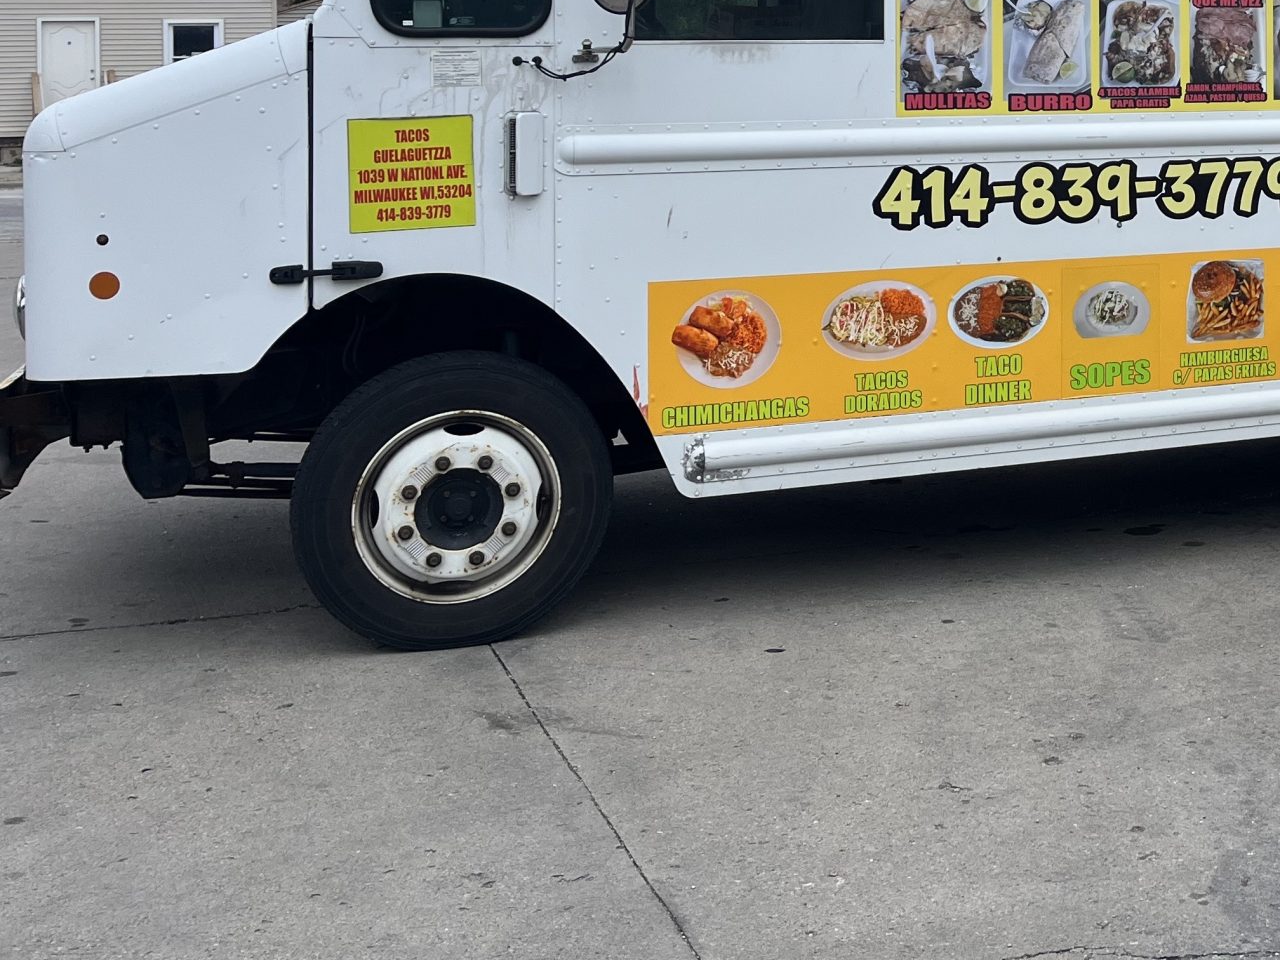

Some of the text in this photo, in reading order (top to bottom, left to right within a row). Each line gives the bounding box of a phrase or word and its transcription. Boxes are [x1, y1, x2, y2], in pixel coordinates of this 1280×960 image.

[905, 92, 991, 110] MULITAS
[1009, 93, 1092, 111] BURRO
[1098, 87, 1180, 97] 4 TACOS ALAMBRE
[1111, 99, 1169, 108] PAPA GRATIS
[394, 128, 430, 143] TACOS
[373, 147, 451, 163] GUELAGUETZZA
[357, 165, 468, 184] 1039 W NATIONL AVE.
[354, 184, 472, 204] MILWAUKEE WI,53204
[376, 204, 451, 222] 414-839-3779
[975, 354, 1022, 378] TACO
[1180, 346, 1268, 367] HAMBURGUESA
[854, 370, 908, 391] TACOS
[1070, 359, 1151, 390] SOPES
[1173, 361, 1276, 385] C/ PAPAS FRITAS
[844, 390, 922, 413] DORADOS
[965, 380, 1031, 405] DINNER
[662, 397, 810, 428] CHIMICHANGAS
